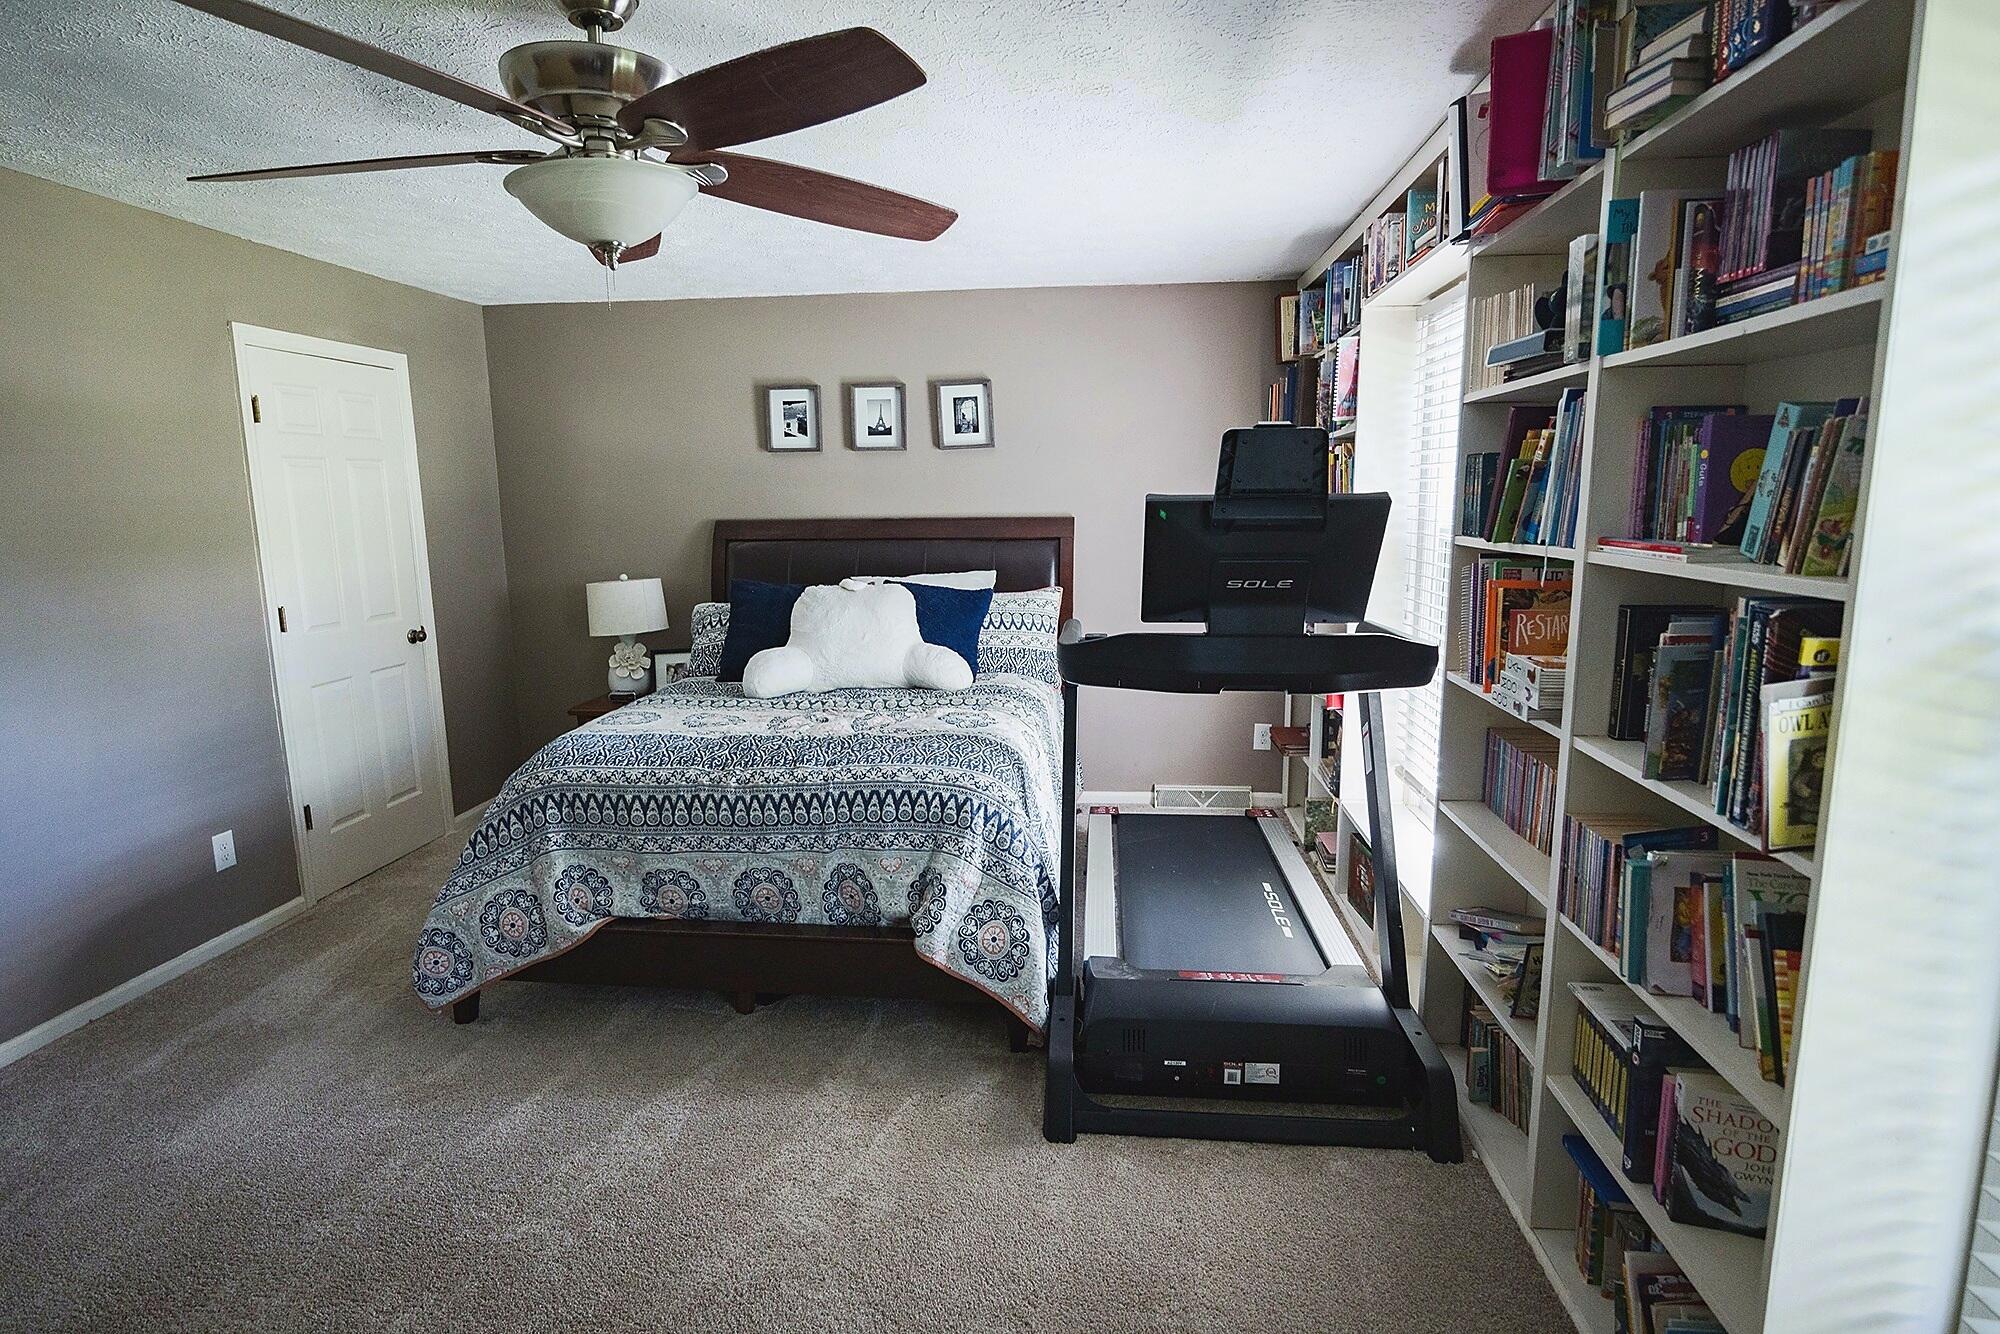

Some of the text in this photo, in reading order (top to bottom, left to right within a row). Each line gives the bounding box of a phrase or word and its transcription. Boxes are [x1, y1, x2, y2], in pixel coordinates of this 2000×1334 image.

[1226, 580, 1293, 588] SOLE
[1516, 613, 1569, 647] RESTAR
[1778, 713, 1815, 734] OWL
[1263, 891, 1292, 928] SOLE
[1698, 1096, 1720, 1108] THE
[1747, 1132, 1771, 1144] THE
[1713, 1137, 1777, 1163] GOD
[1744, 1162, 1775, 1176] JOH
[1733, 1171, 1774, 1185] GWYN
